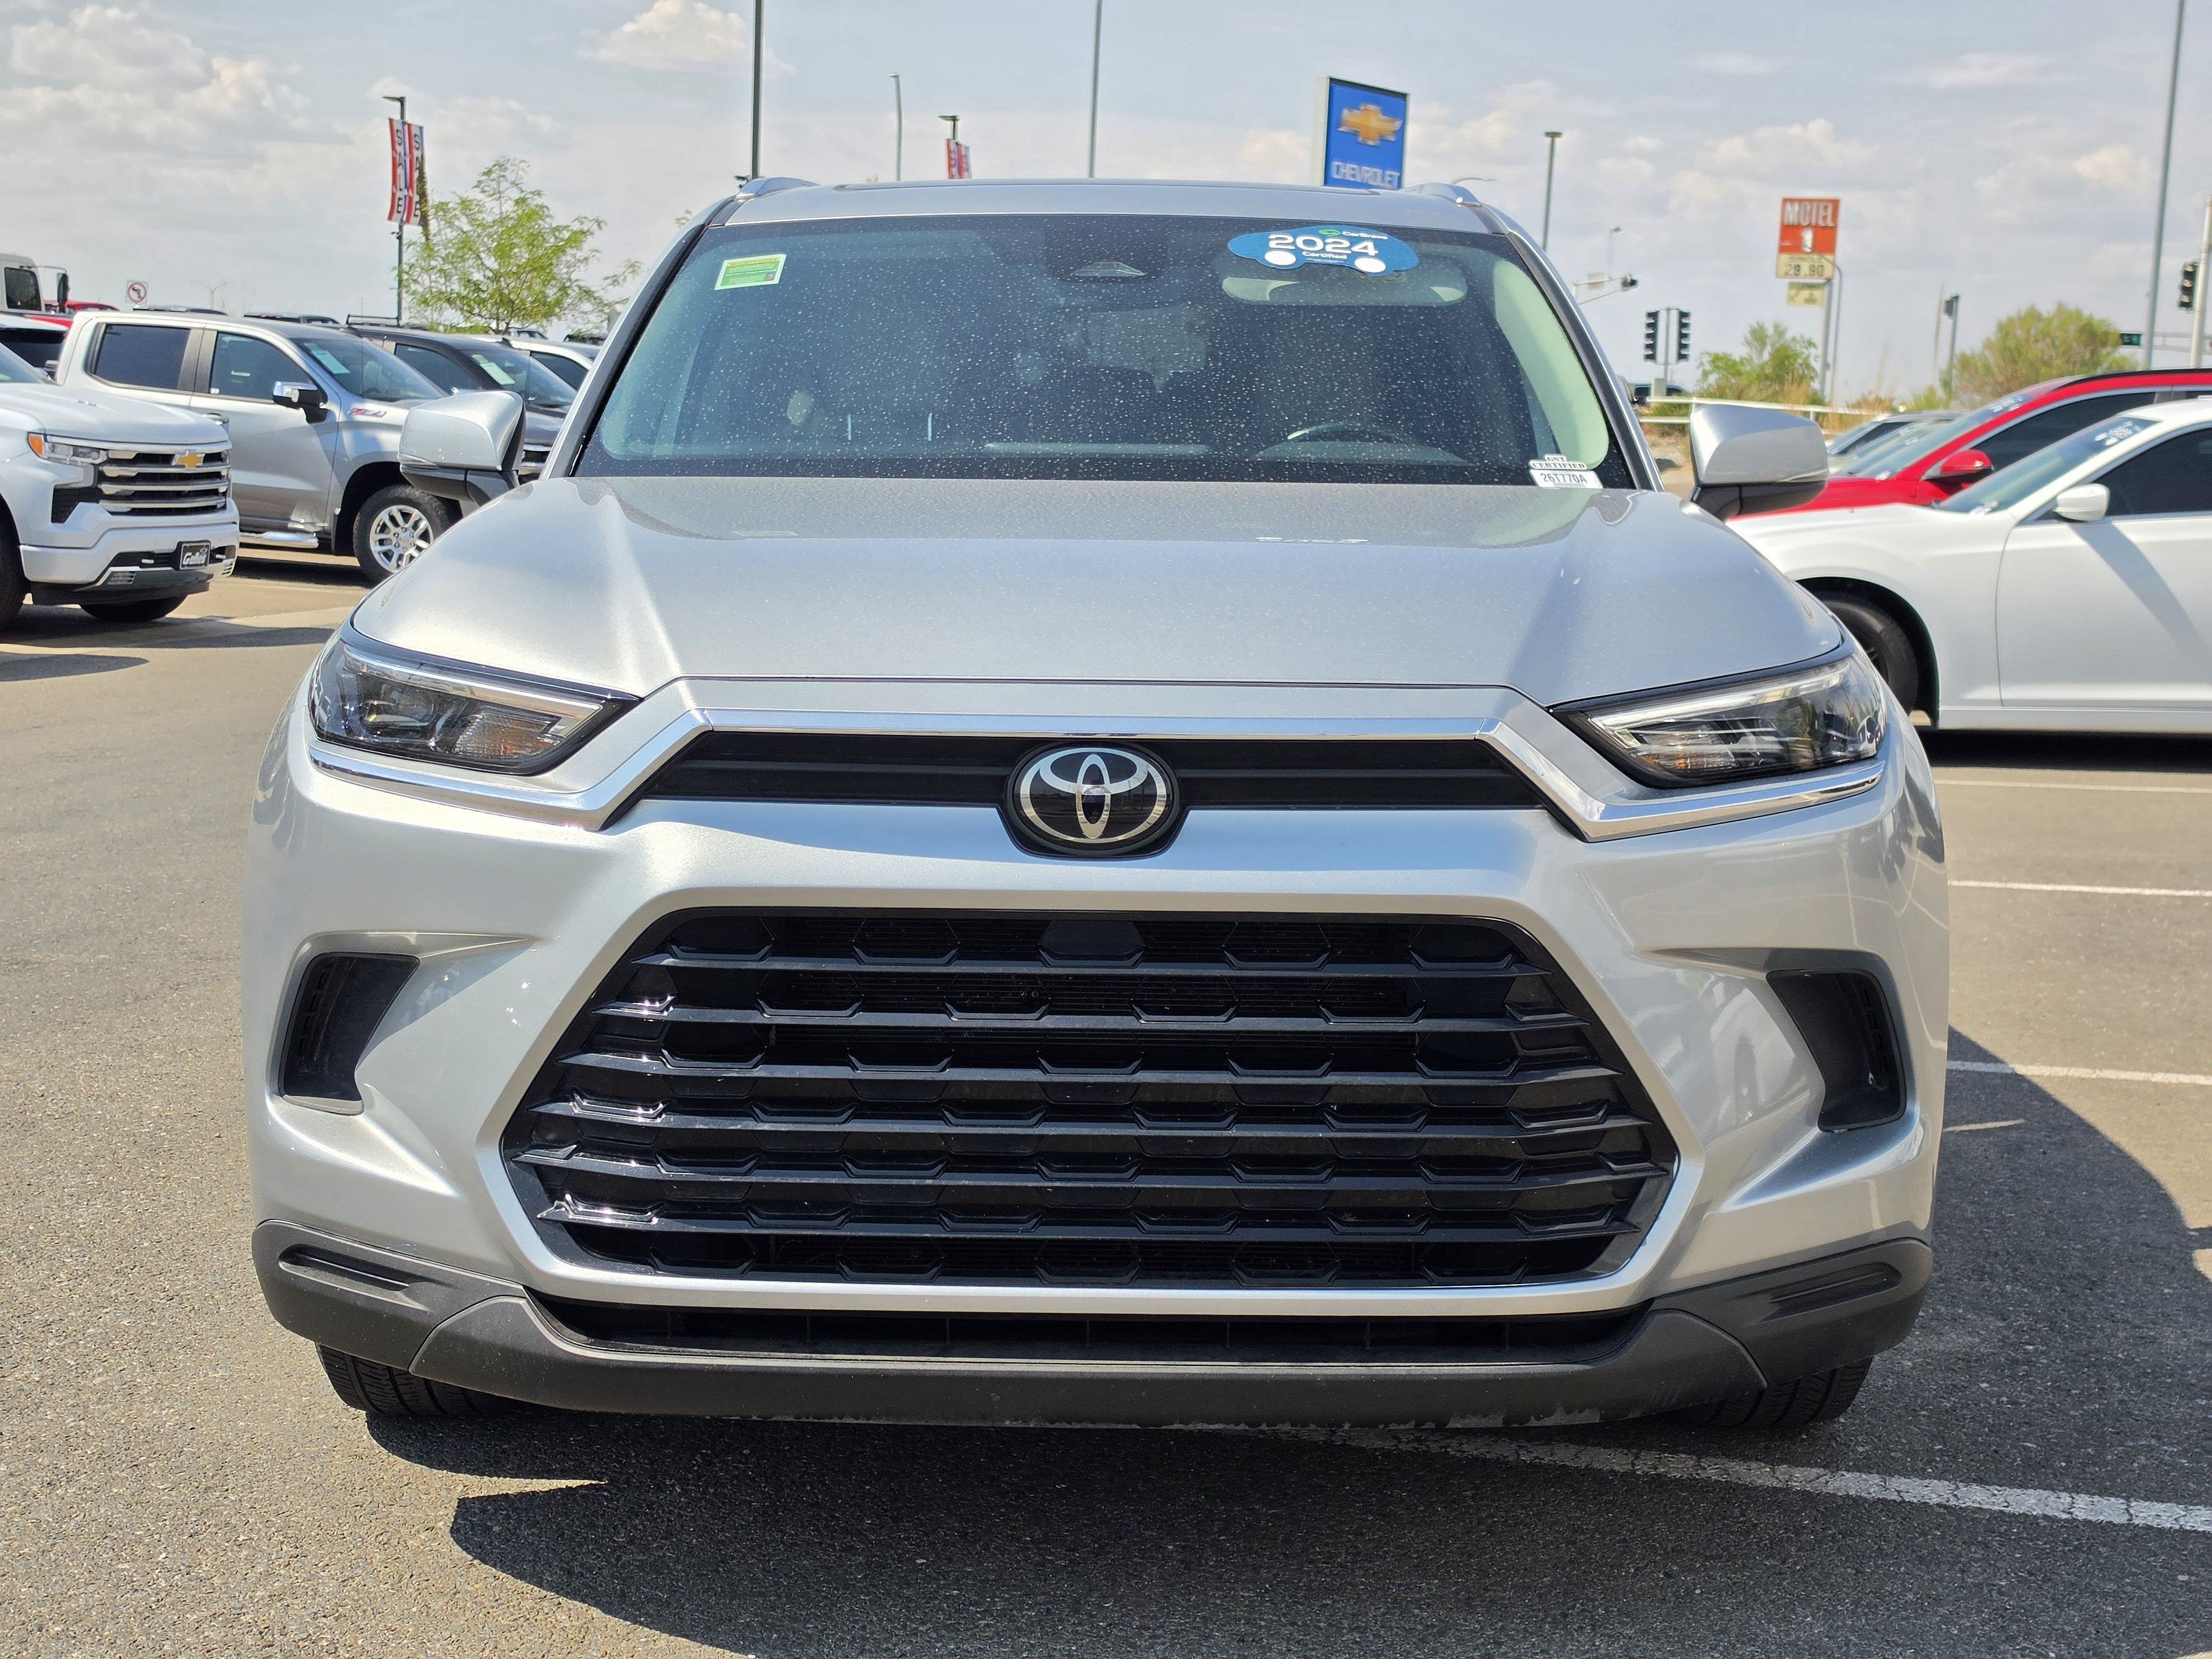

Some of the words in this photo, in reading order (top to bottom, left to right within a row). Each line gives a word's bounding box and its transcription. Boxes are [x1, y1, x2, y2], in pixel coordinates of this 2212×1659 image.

[1332, 160, 1401, 189] CHEVROLET
[1784, 201, 1835, 227] MOTEL
[1269, 234, 1379, 256] 2024
[1302, 251, 1347, 259] Certified
